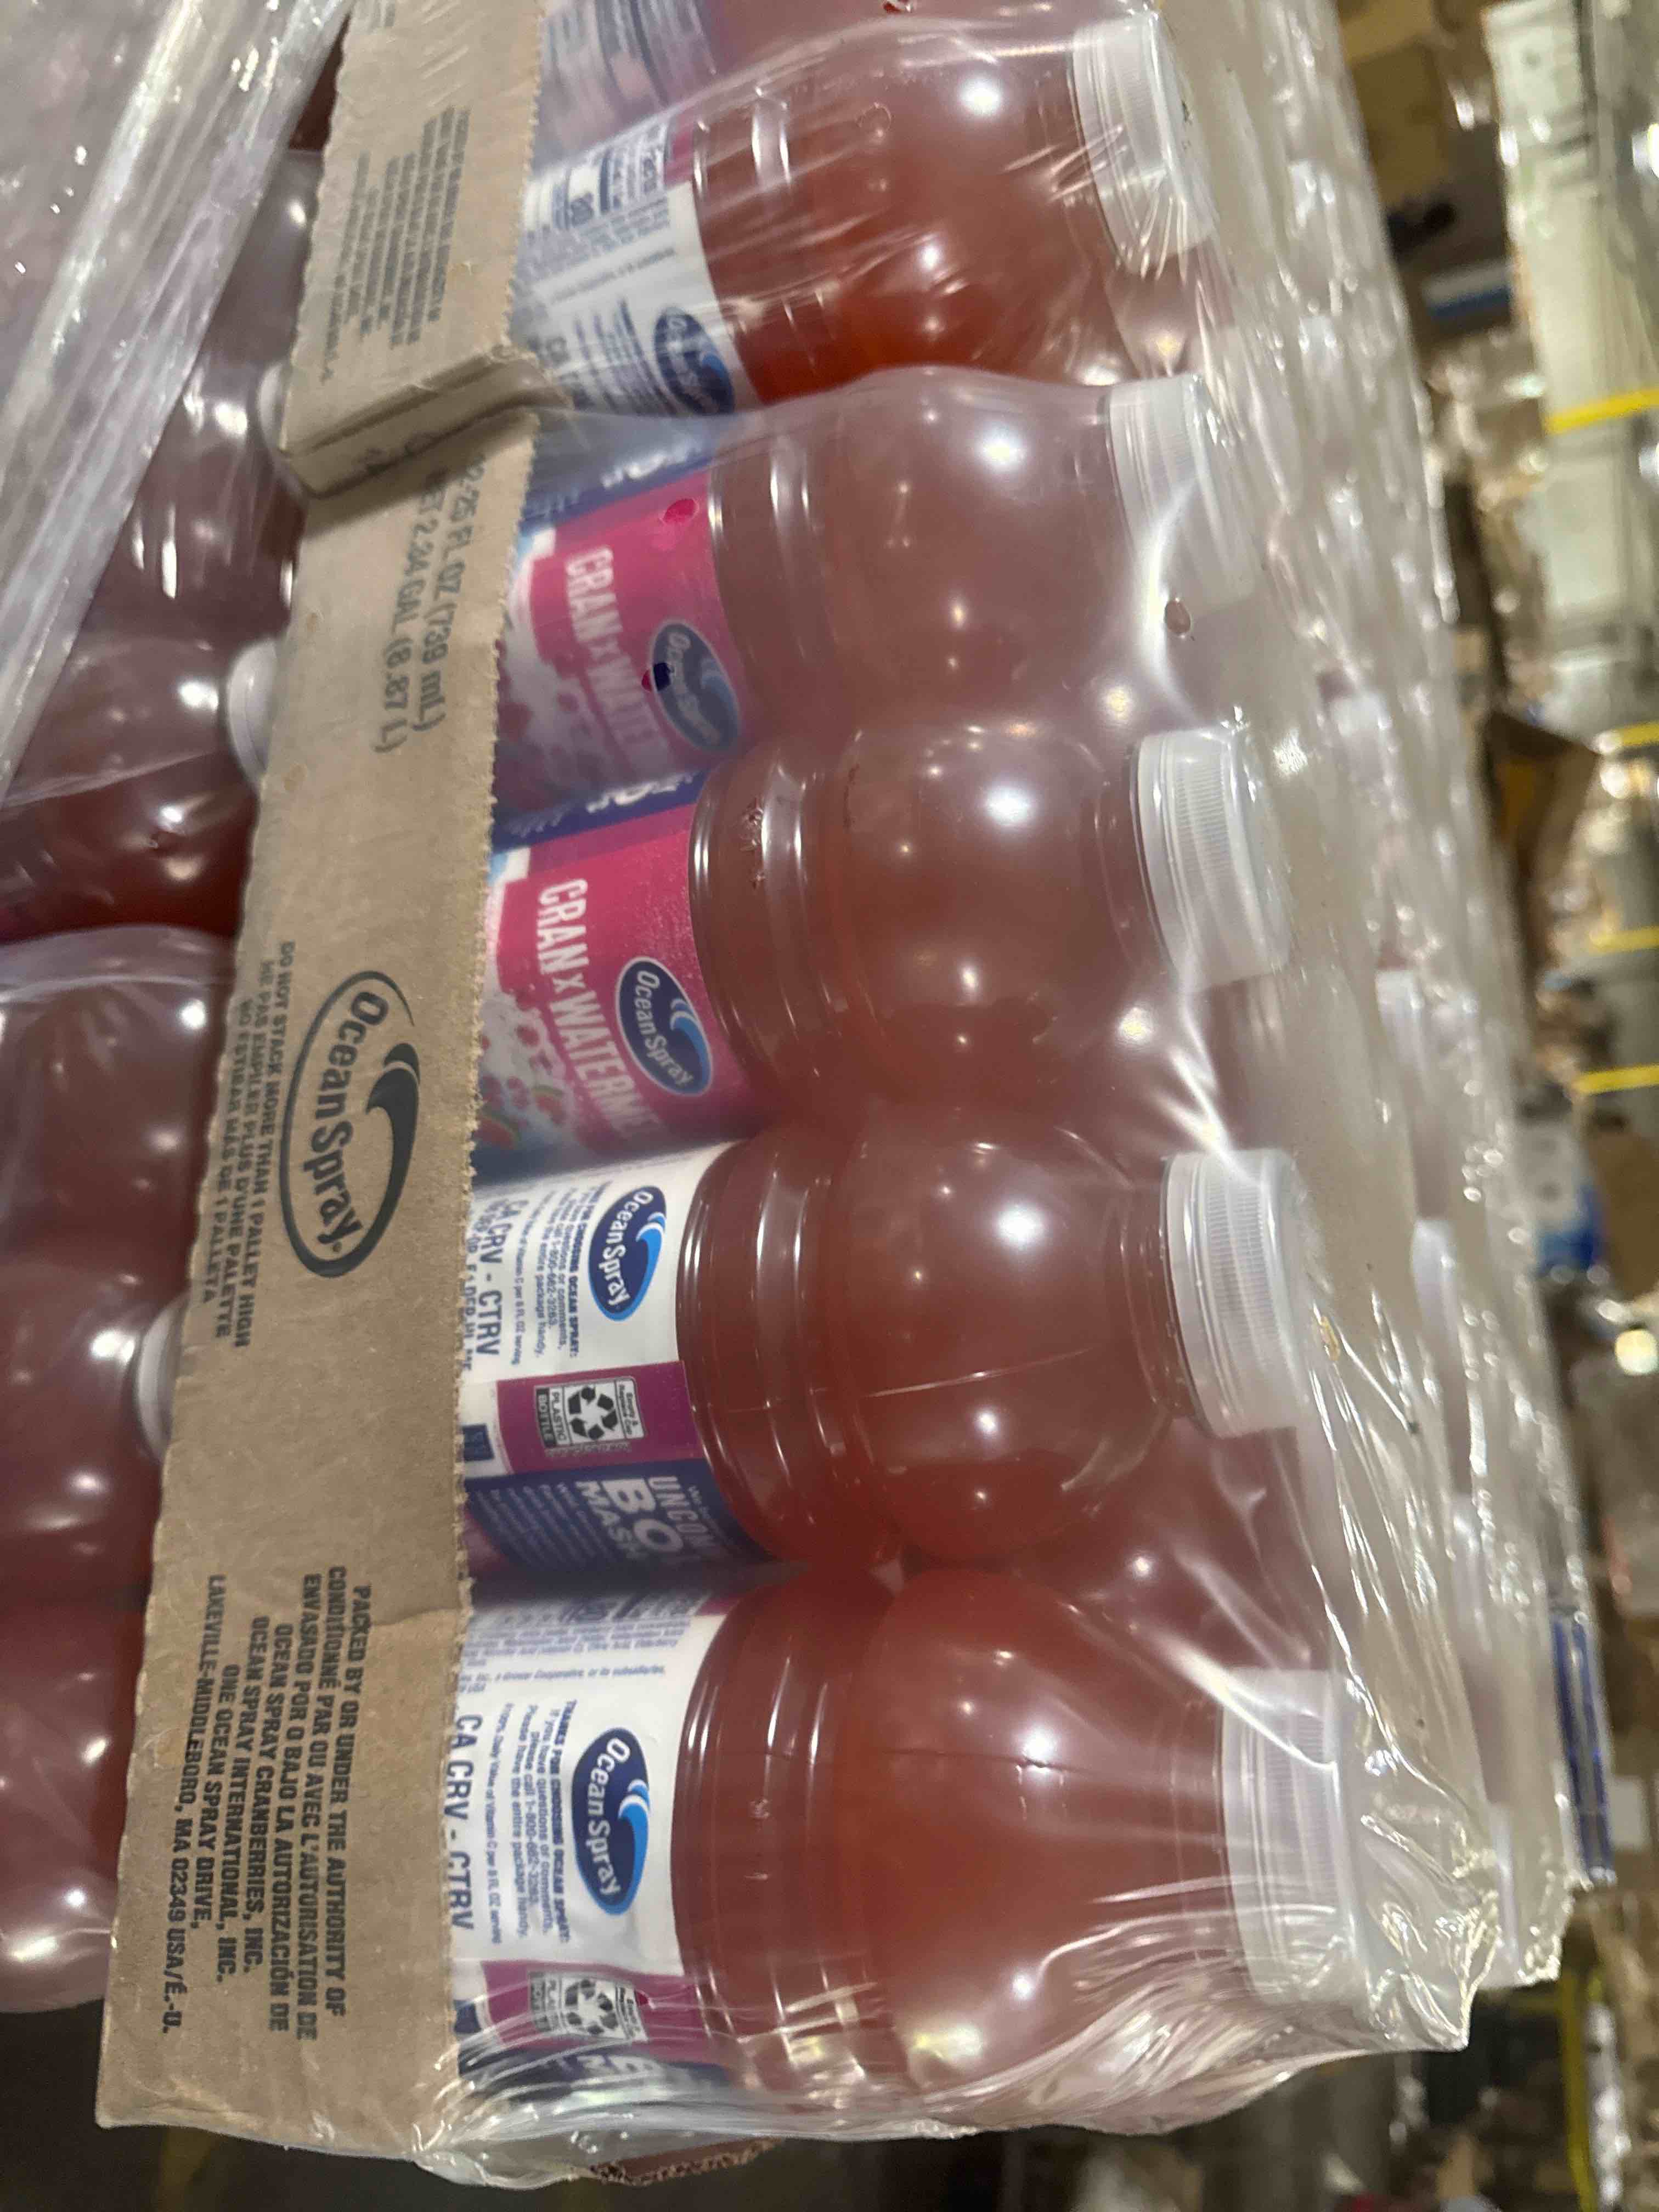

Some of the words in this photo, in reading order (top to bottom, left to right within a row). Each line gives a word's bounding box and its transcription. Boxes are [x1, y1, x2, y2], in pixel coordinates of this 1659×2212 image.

[391, 579, 426, 635] GAL
[433, 561, 466, 602] OZ
[565, 547, 624, 642] CRAN
[421, 602, 458, 664] (739
[383, 637, 414, 710] (8.87
[411, 670, 446, 731] mL)
[375, 719, 408, 753] L)
[537, 879, 589, 974] CRAN
[280, 940, 296, 967] DO
[275, 972, 292, 1009] NOT
[634, 970, 660, 1035] Ocean
[268, 1014, 287, 1076] STACK
[315, 992, 390, 1119] Ocean
[644, 1035, 695, 1088] Spray
[261, 1081, 280, 1137] MORE
[237, 1120, 259, 1171] PLUS
[253, 1139, 273, 1194] THAN
[303, 1120, 363, 1241] Spray
[479, 1223, 512, 1263] CRV
[606, 1191, 653, 1244] Ocean
[242, 1212, 264, 1288] PALLET
[599, 1244, 631, 1306] Spray
[215, 1244, 242, 1338] PALETTE
[535, 1274, 544, 1318] package
[568, 1276, 578, 1312] OCEAN
[235, 1294, 255, 1347] HIGH
[476, 1290, 503, 1355] CTRV
[538, 1394, 553, 1441] BOTTLE
[552, 1392, 567, 1442] PLASTIC
[627, 1392, 635, 1418] Empty
[246, 1616, 270, 1680] OCEAN
[296, 1573, 322, 1674] ENVASADO
[318, 1566, 346, 1689] CONDITIONNÉ
[348, 1585, 372, 1662] PACKED
[269, 1624, 293, 1688] OCEAN
[344, 1667, 364, 1694] BY
[174, 1575, 227, 1813] LAKEVILLE-MIDDLEBORO,
[218, 1664, 240, 1702] ONE
[288, 1680, 312, 1720] POR
[235, 1685, 261, 1751] SPRAY
[259, 1694, 285, 1759] SPRAY
[286, 1726, 304, 1740] O
[312, 1695, 335, 1735] PAR
[339, 1701, 359, 1728] OR
[451, 1715, 483, 1749] CA
[543, 1720, 555, 1742] you
[207, 1709, 233, 1775] OCEAN
[308, 1740, 328, 1767] OU
[329, 1734, 355, 1803] UNDER
[512, 1745, 528, 1774] have
[537, 1746, 550, 1774] have
[550, 1750, 562, 1774] FOR
[279, 1747, 303, 1799] BAJO
[444, 1760, 474, 1820] CRV
[487, 1760, 500, 1787] Value
[511, 1778, 522, 1797] the
[524, 1774, 536, 1796] call
[587, 1737, 631, 1816] Ocean
[198, 1781, 223, 1850] SPRAY
[275, 1806, 295, 1833] LA
[301, 1773, 324, 1827] AVEC
[486, 1802, 496, 1838] Vitamin
[512, 1801, 522, 1837] entire
[537, 1779, 549, 1841] questions
[551, 1779, 563, 1845] CHOOSING
[173, 1818, 193, 1853] MA
[216, 1757, 251, 1930] INTERNATIONAL,
[242, 1765, 275, 1920] CRANBERRIES,
[327, 1809, 347, 1851] THE
[540, 1844, 550, 1858] or
[486, 1851, 495, 1867] per
[510, 1842, 526, 1893] package
[554, 1849, 565, 1894] OCEAN
[585, 1820, 622, 1895] Spray
[167, 1858, 189, 1922] 02349
[191, 1857, 215, 1928] DRIVE,
[449, 1851, 474, 1929] CTRV
[270, 1838, 295, 1997] AUTORIZACIÓN
[297, 1833, 320, 2006] L'AUTORISATION
[325, 1858, 346, 1981] AUTHORITY
[217, 1937, 238, 1983] INC.
[244, 1927, 264, 1973] INC.
[269, 2003, 290, 2032] DE
[297, 2012, 317, 2041] DE
[325, 1987, 346, 2017] OF
